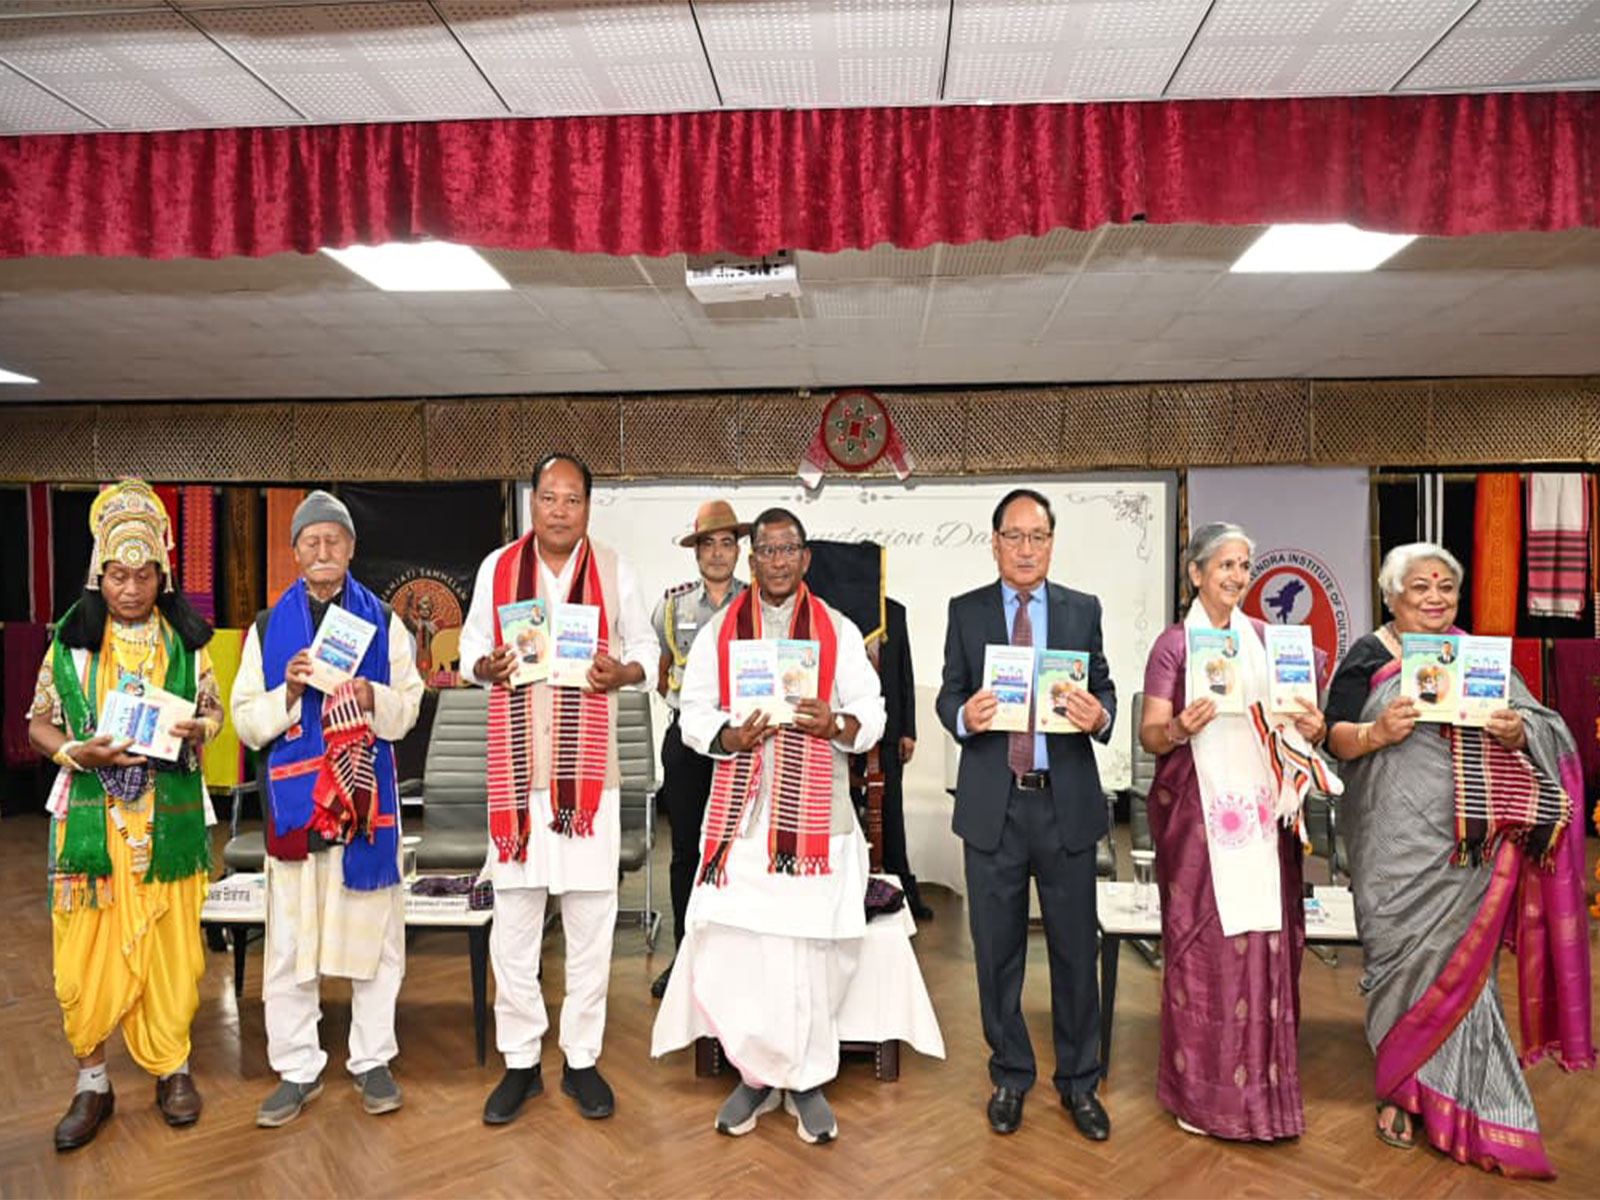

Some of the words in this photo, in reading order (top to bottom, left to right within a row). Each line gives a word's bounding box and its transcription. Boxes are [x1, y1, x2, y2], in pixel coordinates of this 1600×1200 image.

[932, 520, 993, 547] Da
[1250, 553, 1286, 581] ENDRA
[1288, 552, 1334, 592] INSTITUTE
[1331, 592, 1341, 607] OF
[1335, 610, 1347, 659] CULTUR
